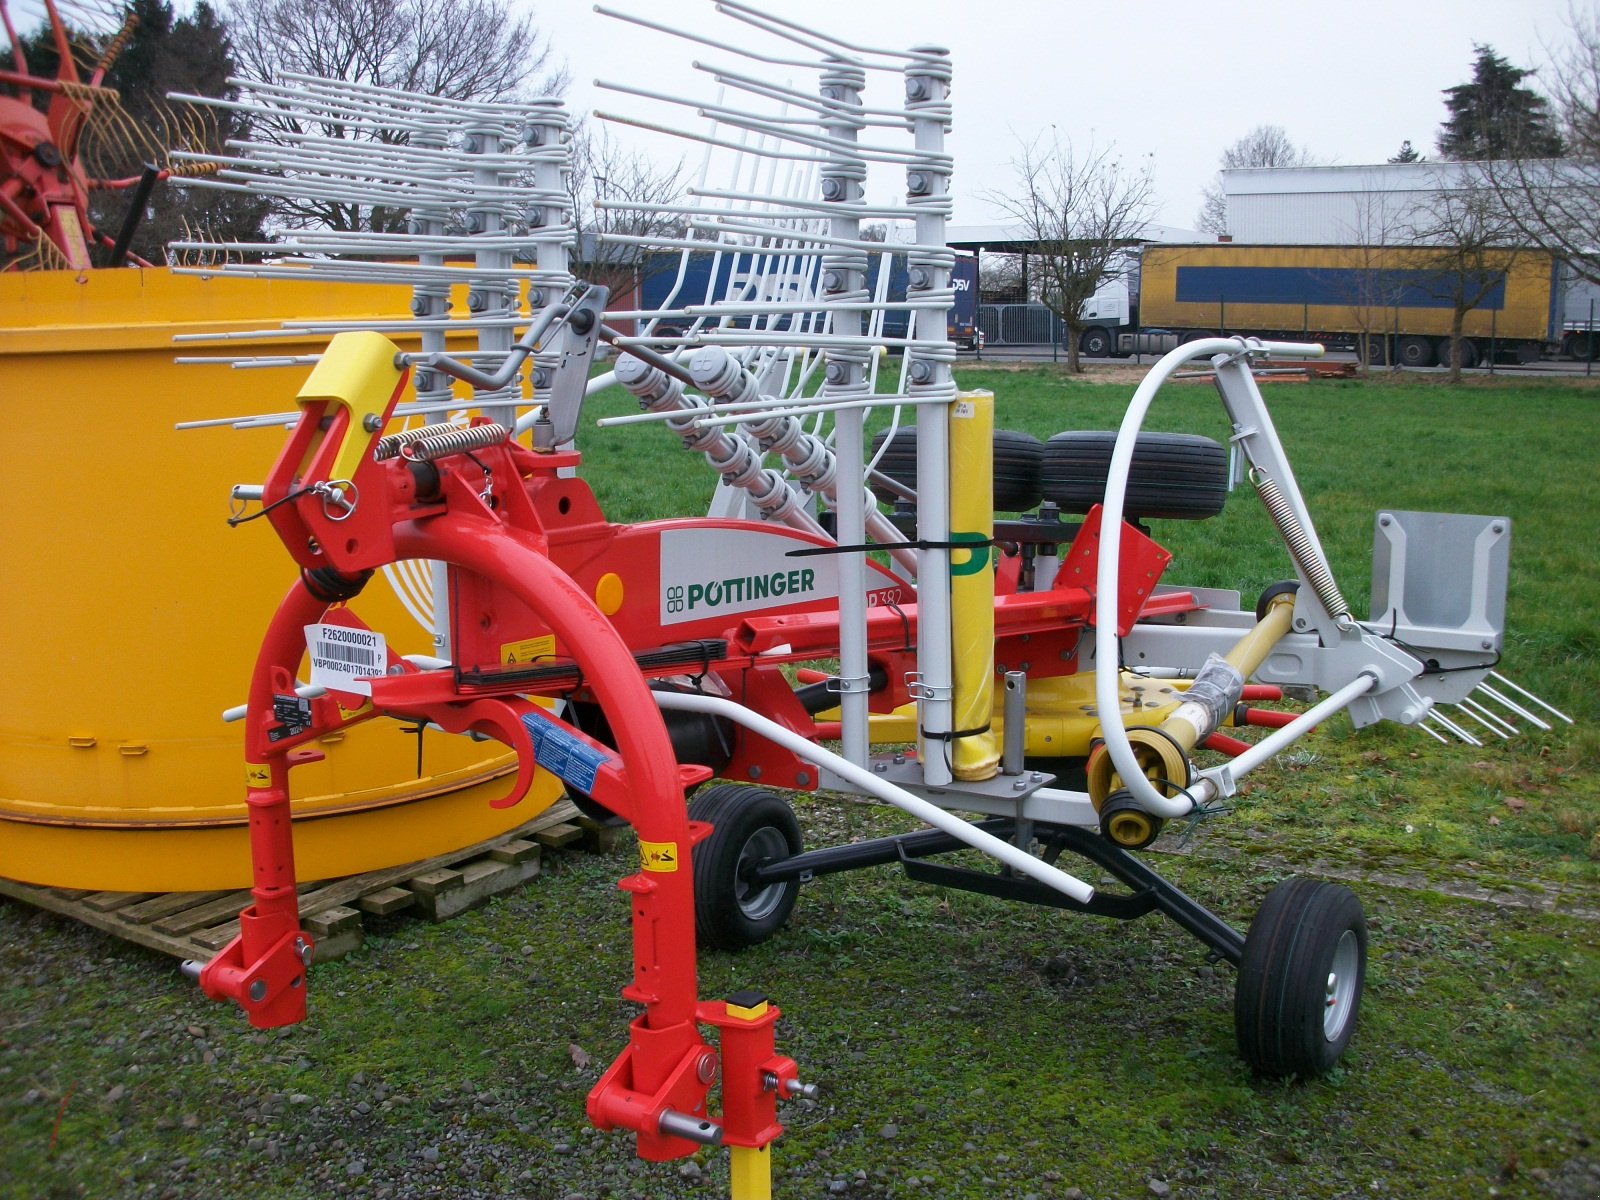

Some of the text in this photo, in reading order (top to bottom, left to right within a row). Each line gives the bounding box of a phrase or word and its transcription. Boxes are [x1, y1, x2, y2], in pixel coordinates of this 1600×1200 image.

[952, 278, 970, 291] DSV
[687, 568, 815, 610] PÖTTINGER
[323, 628, 376, 646] F2620000021
